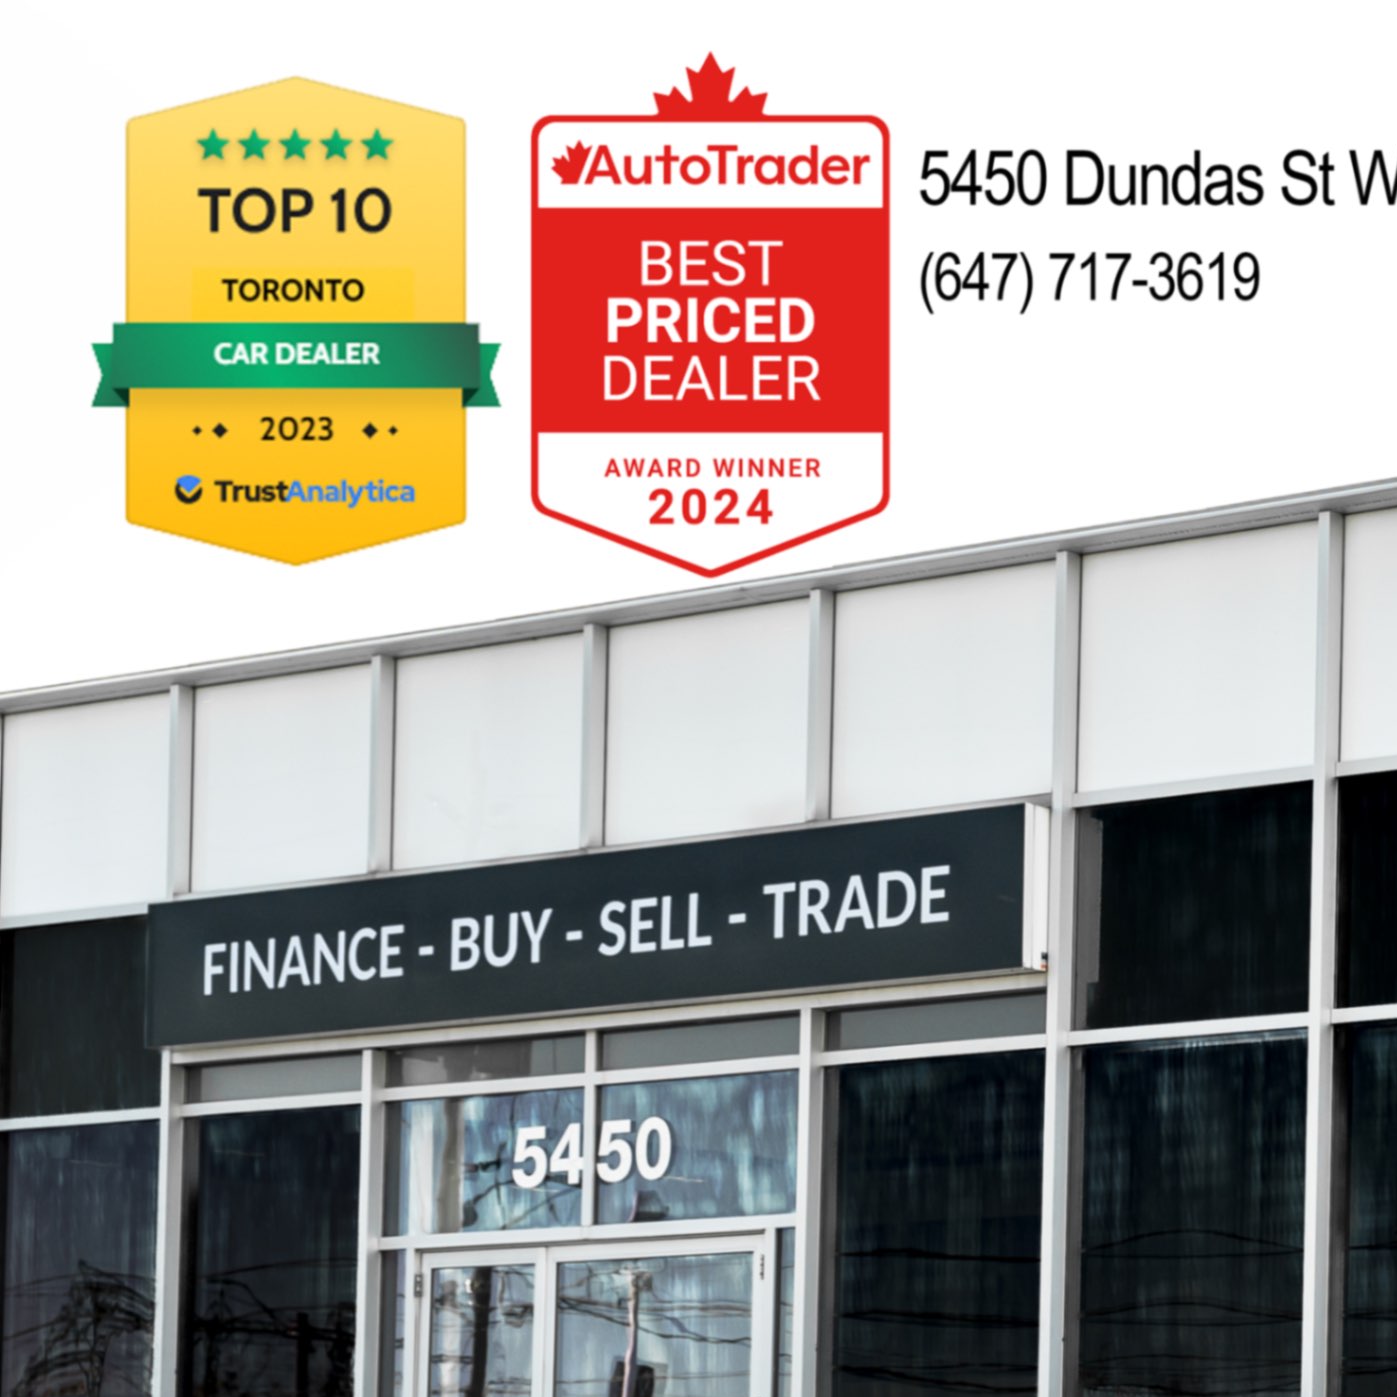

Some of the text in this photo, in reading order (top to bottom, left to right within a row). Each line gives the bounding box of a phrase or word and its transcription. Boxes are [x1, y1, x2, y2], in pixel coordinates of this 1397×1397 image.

[202, 924, 406, 996] FINANCE
[450, 908, 553, 972] BUY
[598, 892, 712, 957] SELL
[763, 863, 951, 939] TRADE
[511, 1115, 673, 1189] 5450
